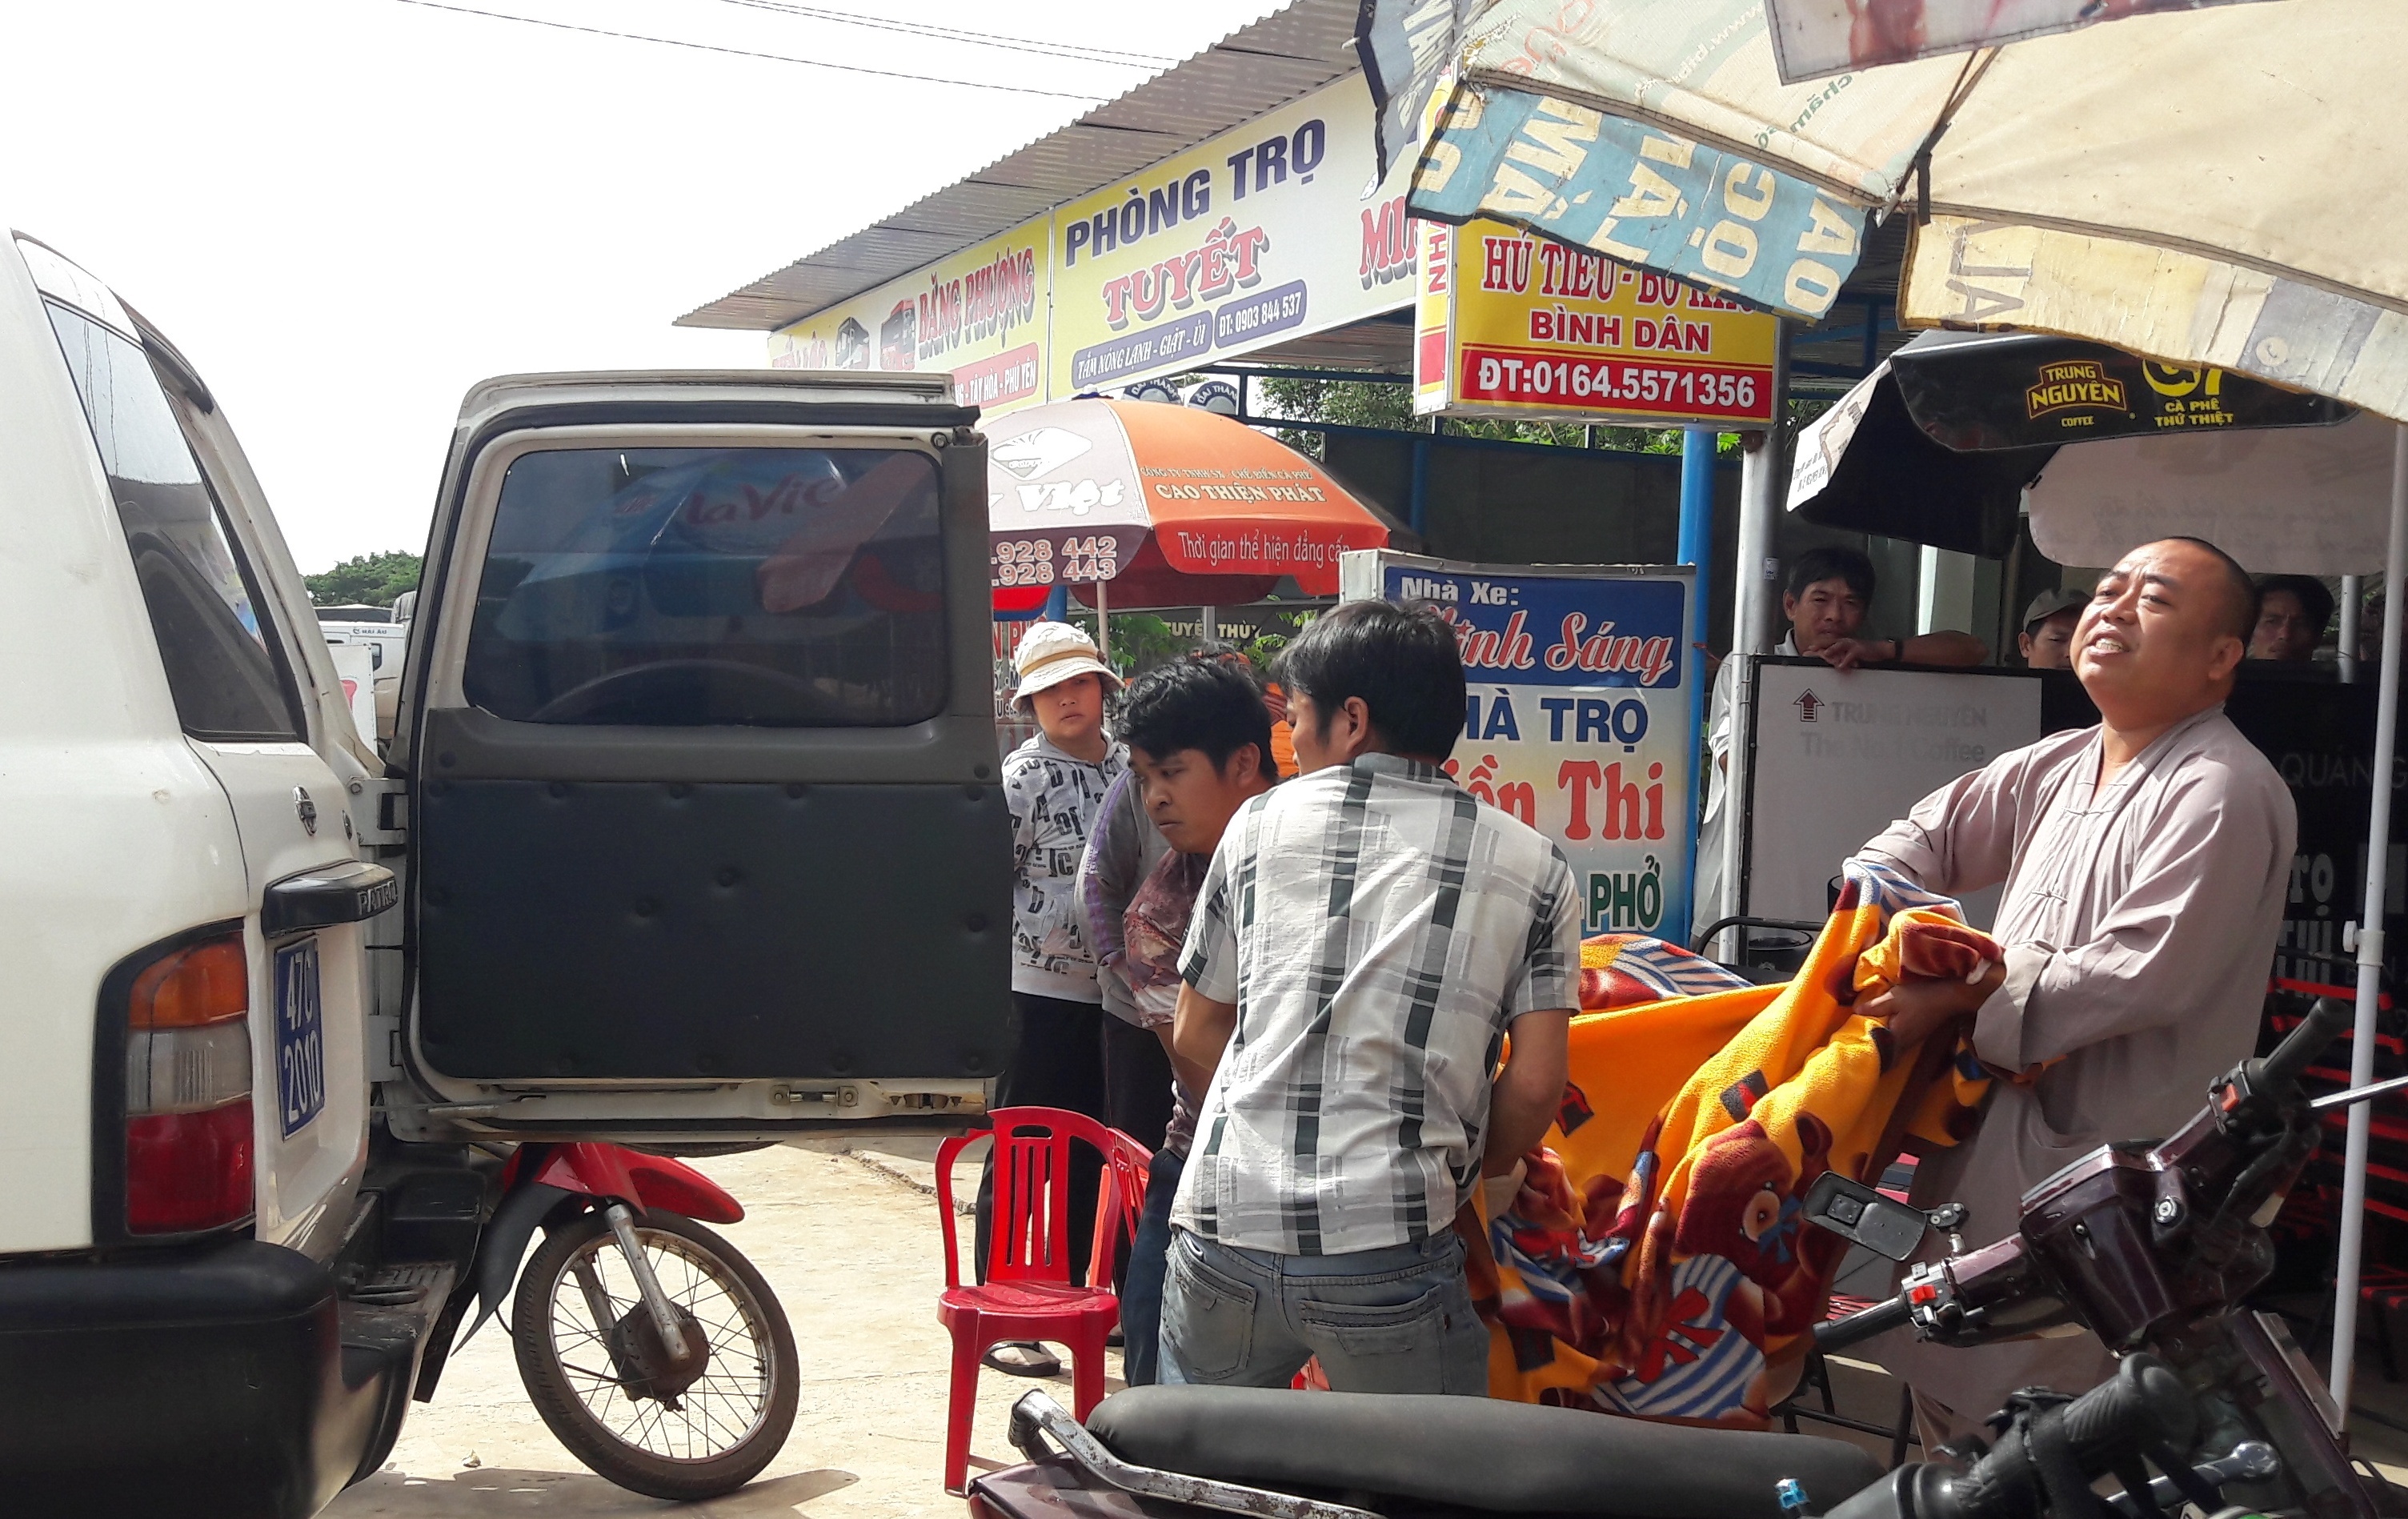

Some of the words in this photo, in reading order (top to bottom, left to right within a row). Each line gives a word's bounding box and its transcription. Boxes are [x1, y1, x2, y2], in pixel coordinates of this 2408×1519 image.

[1066, 169, 1211, 268] PHÒNG
[1228, 119, 1326, 202] TRỌ
[1102, 216, 1266, 325] TUYẾT
[1235, 305, 1260, 333] 0903
[1261, 299, 1280, 326] 844
[1282, 291, 1302, 319] 537
[1531, 306, 1621, 347] BÌNH
[1635, 315, 1711, 353] DÂN
[1004, 359, 1020, 395] PHÚ
[1021, 355, 1036, 391] YÊN
[1124, 340, 1152, 371] LẠNH
[2045, 365, 2097, 383] TRUNG
[1478, 356, 1757, 409] ĐT:0164.5571356
[2030, 380, 2122, 411] NGUYÊN
[2061, 415, 2095, 428] COFFEE
[2164, 399, 2186, 414] CÀ
[2189, 397, 2221, 411] PHÊ
[2189, 411, 2234, 427] THIỆT
[1154, 483, 1201, 500] CAO
[1200, 481, 1269, 504] THIỆN
[1267, 483, 1328, 503] PHÁT
[1061, 535, 1117, 559] 442
[1177, 531, 1208, 559] Thời
[1209, 534, 1236, 567] gian
[1240, 527, 1260, 560] thể
[1264, 534, 1289, 567] hiện
[1062, 558, 1116, 582] 443
[1400, 576, 1459, 601] Nhà
[1469, 581, 1521, 606] Xe:
[1545, 611, 1674, 687] Sáng
[1540, 697, 1649, 753] TRỌ
[1557, 759, 1665, 840] Thi
[1589, 853, 1662, 929] PHỞ
[286, 951, 314, 1031] 47C
[284, 1029, 321, 1124] 2010
